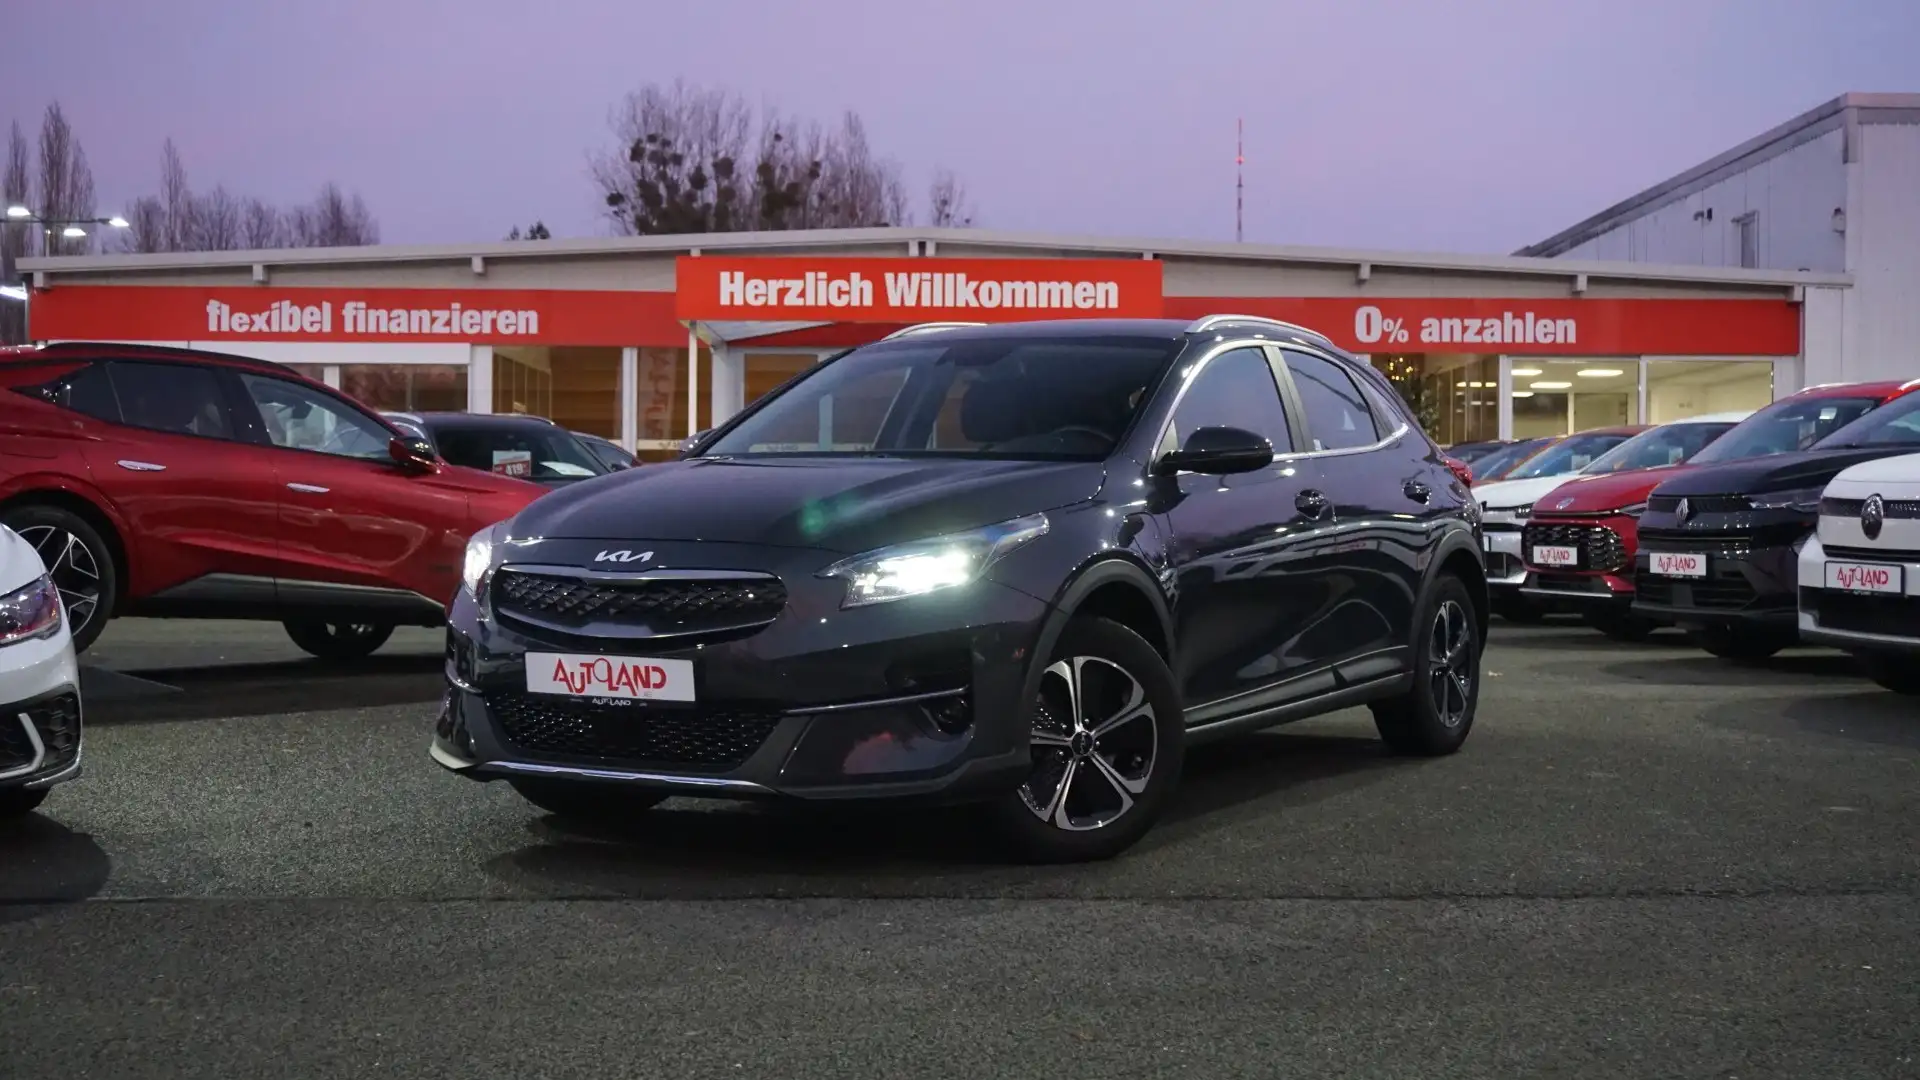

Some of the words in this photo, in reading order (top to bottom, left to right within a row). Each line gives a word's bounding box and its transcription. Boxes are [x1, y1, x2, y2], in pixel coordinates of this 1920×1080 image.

[719, 271, 873, 307] Herzlich
[884, 272, 1119, 308] Willkommen
[206, 299, 332, 333] flexibel
[342, 301, 539, 335] finanzieren
[1354, 306, 1410, 343] 0%
[1420, 311, 1577, 344] anzahlen
[1657, 554, 1697, 573] AUTOLAND
[1837, 565, 1889, 589] AUTOLAND
[552, 657, 667, 697] AUTOLAND
